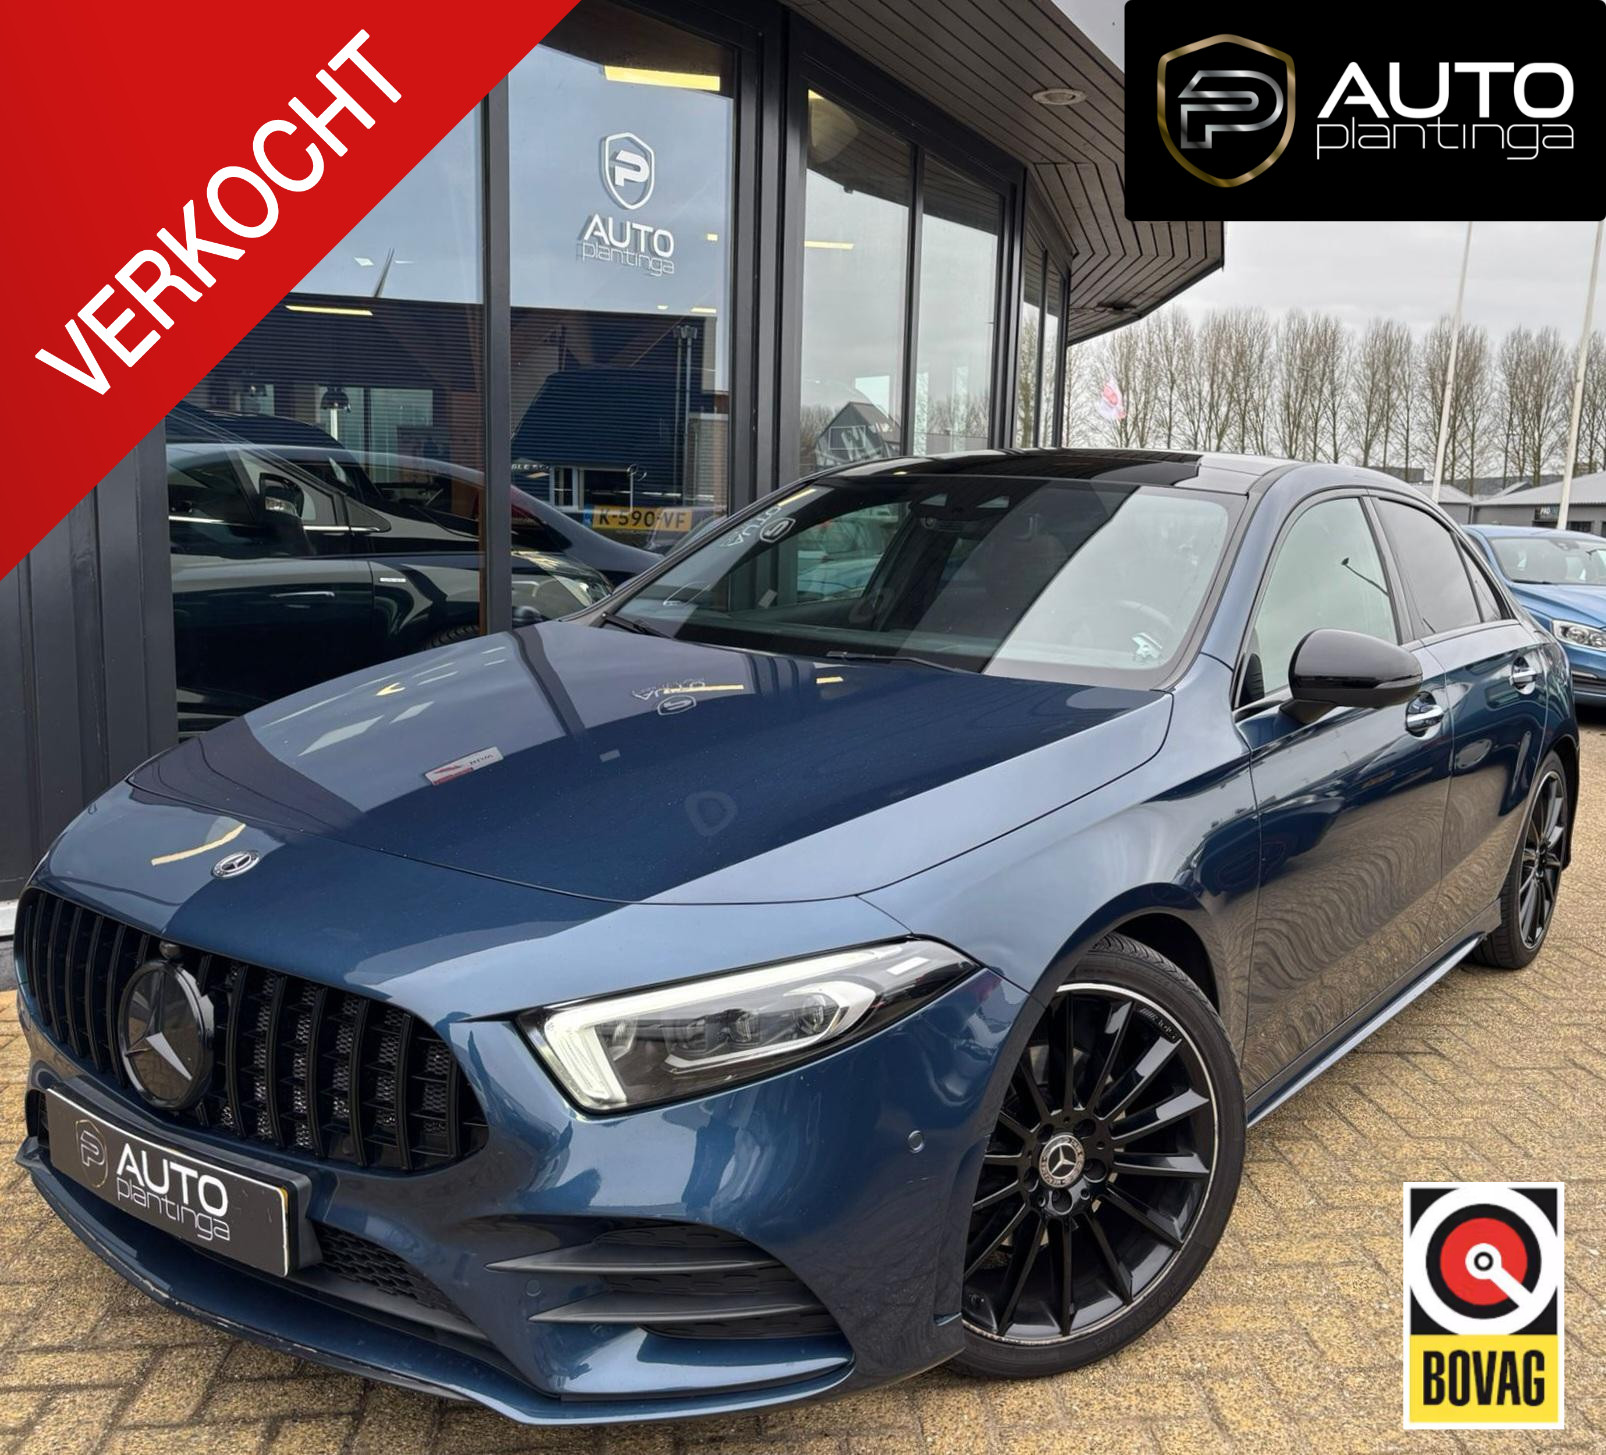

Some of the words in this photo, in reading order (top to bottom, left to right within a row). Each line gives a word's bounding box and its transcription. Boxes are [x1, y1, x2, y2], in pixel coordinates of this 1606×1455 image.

[583, 213, 675, 258] AUTO
[582, 240, 675, 277] plantinga
[599, 508, 687, 529] K-590-VF
[116, 1142, 229, 1218] AUTO
[115, 1176, 231, 1242] plantinga
